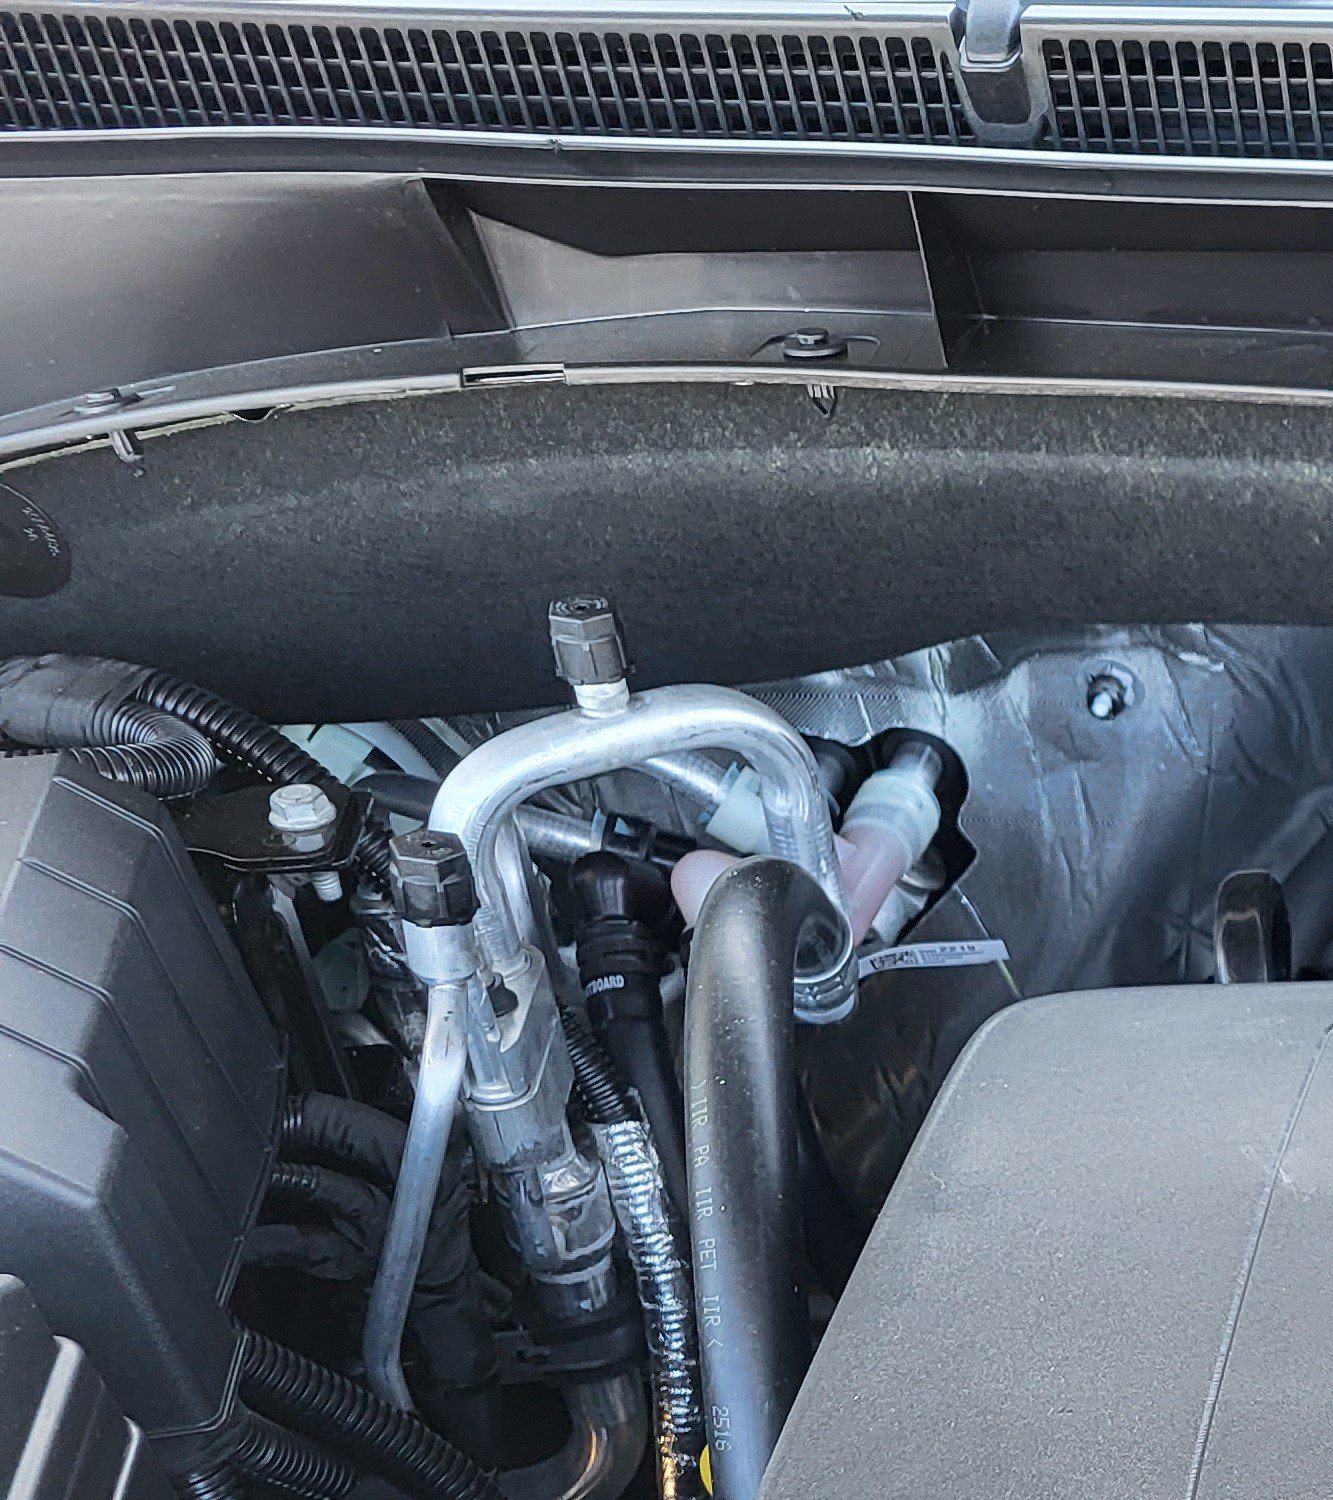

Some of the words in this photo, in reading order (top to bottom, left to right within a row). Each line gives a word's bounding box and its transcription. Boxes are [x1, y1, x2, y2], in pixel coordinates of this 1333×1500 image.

[694, 1144, 710, 1168] PA
[699, 1237, 717, 1271] PET
[711, 1404, 732, 1452] 2516
